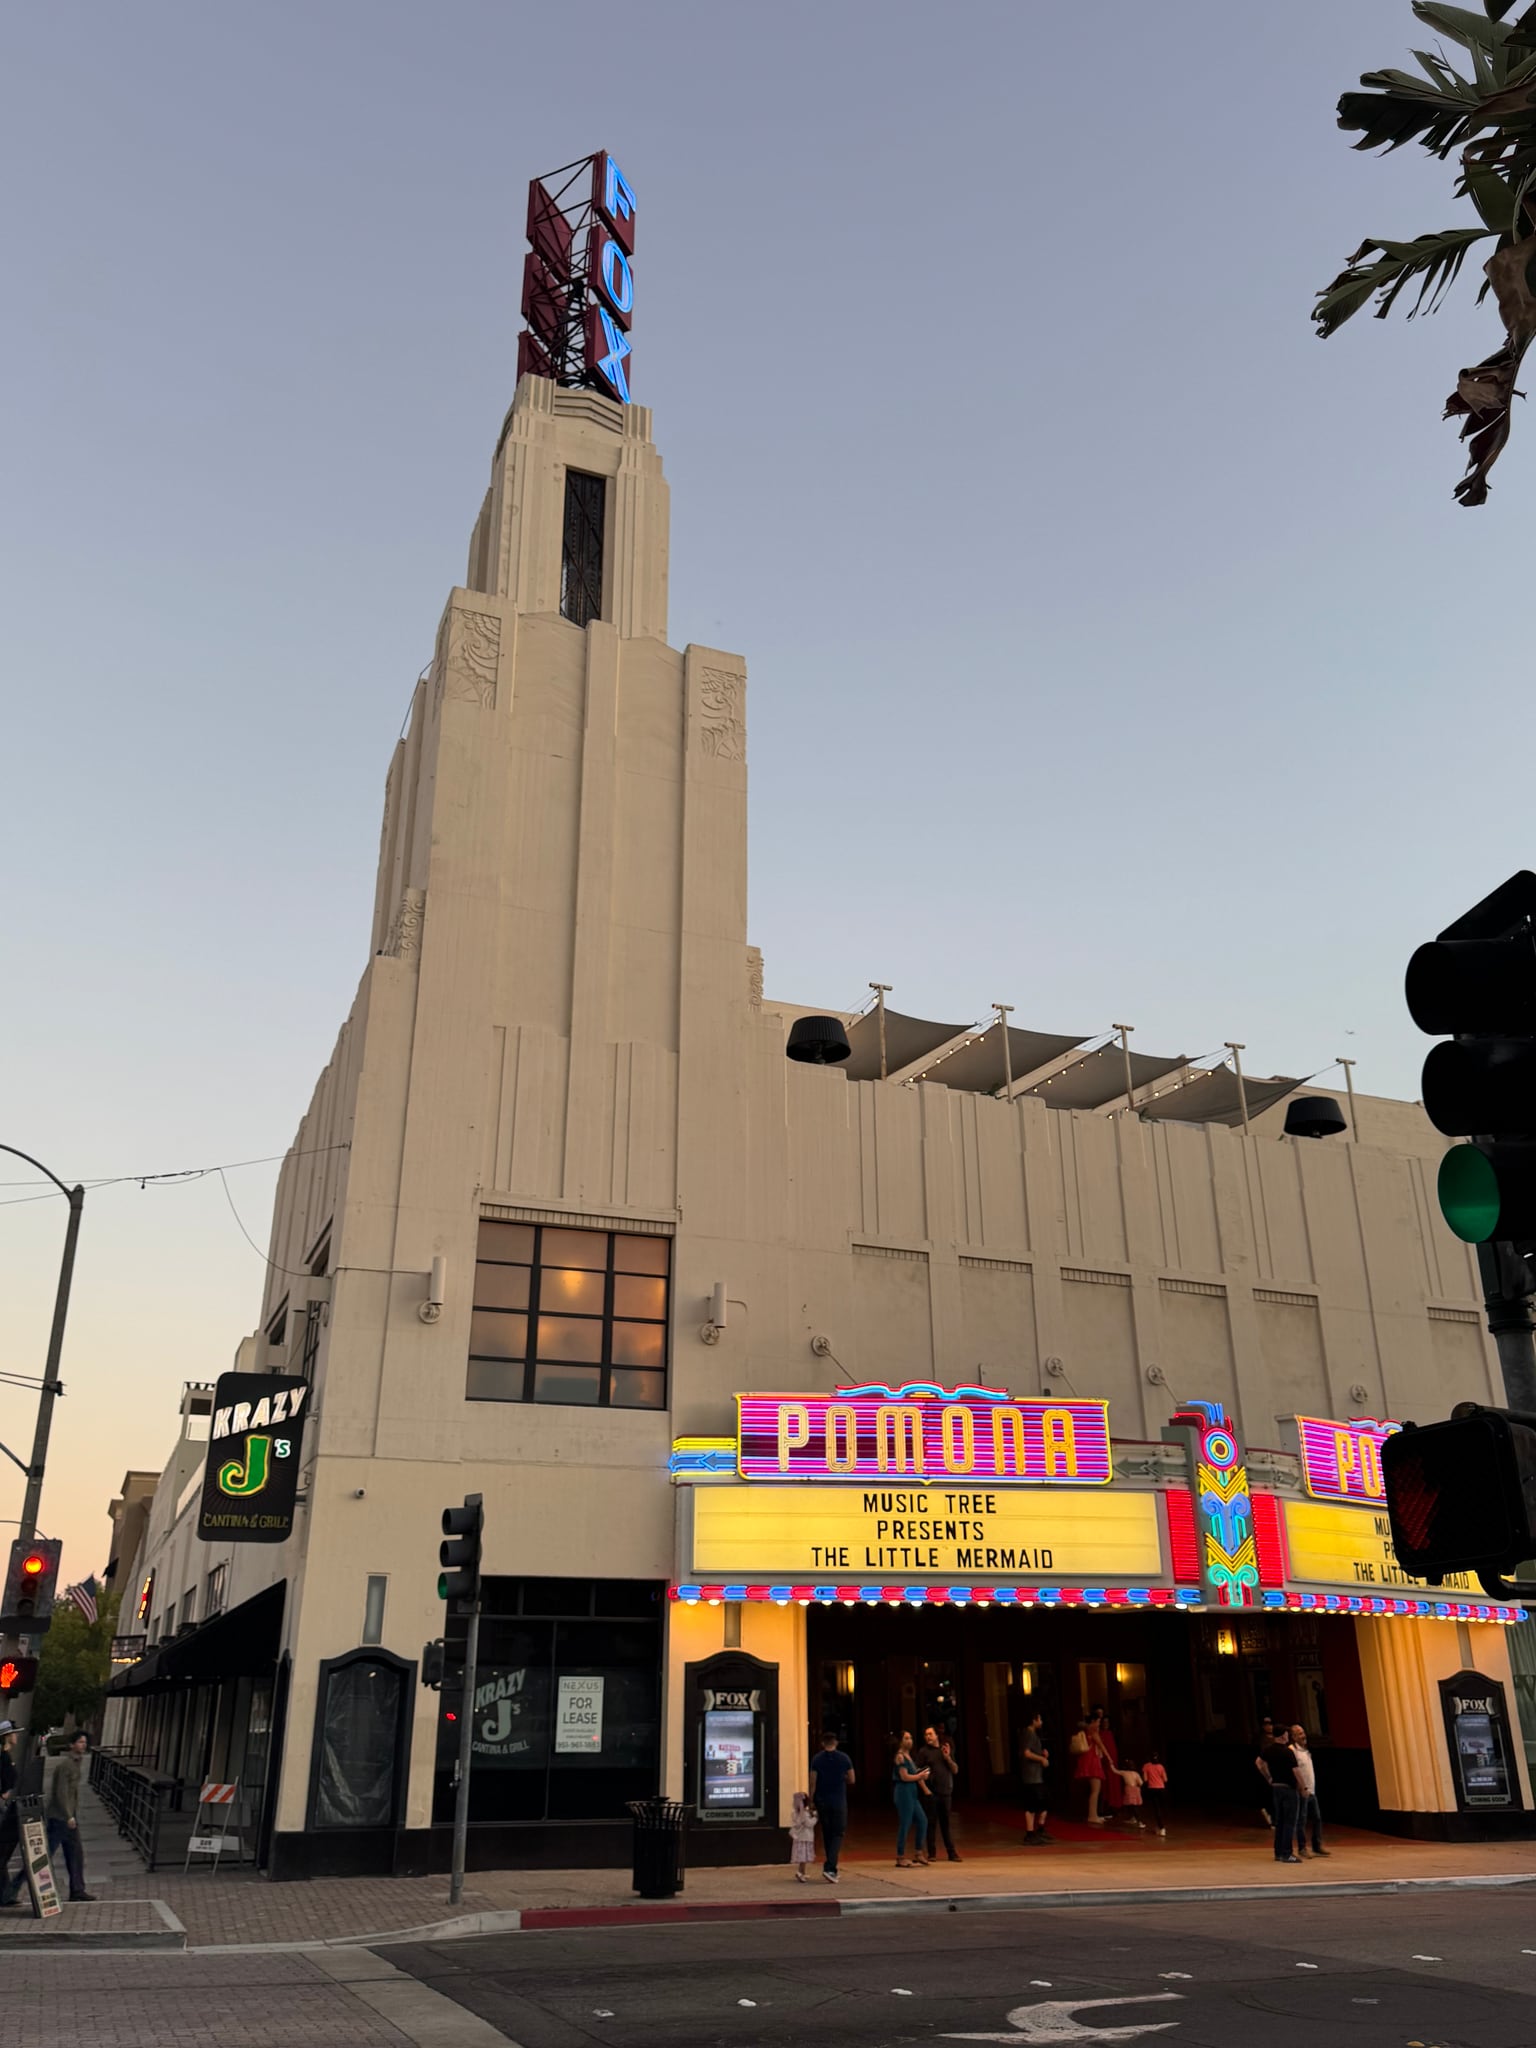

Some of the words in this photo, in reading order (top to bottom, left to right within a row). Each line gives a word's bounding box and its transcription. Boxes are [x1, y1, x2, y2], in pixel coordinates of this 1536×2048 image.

[598, 153, 637, 404] FOX
[212, 1386, 307, 1441] KRAZY
[776, 1405, 1078, 1478] POMONA
[863, 1493, 928, 1514] MUSIC
[946, 1494, 997, 1514] TREE
[877, 1520, 984, 1541] PRESENTS
[811, 1547, 849, 1567] THE
[865, 1547, 939, 1568] LITTLE
[957, 1548, 1053, 1569] MERMAID
[1353, 1561, 1375, 1582] THE
[475, 1668, 526, 1708] KRAZY
[563, 1681, 599, 1690] NEXUS
[569, 1697, 592, 1709] FOR
[715, 1692, 748, 1706] FOX
[1462, 1699, 1486, 1711] FOX
[562, 1712, 598, 1725] LEASE
